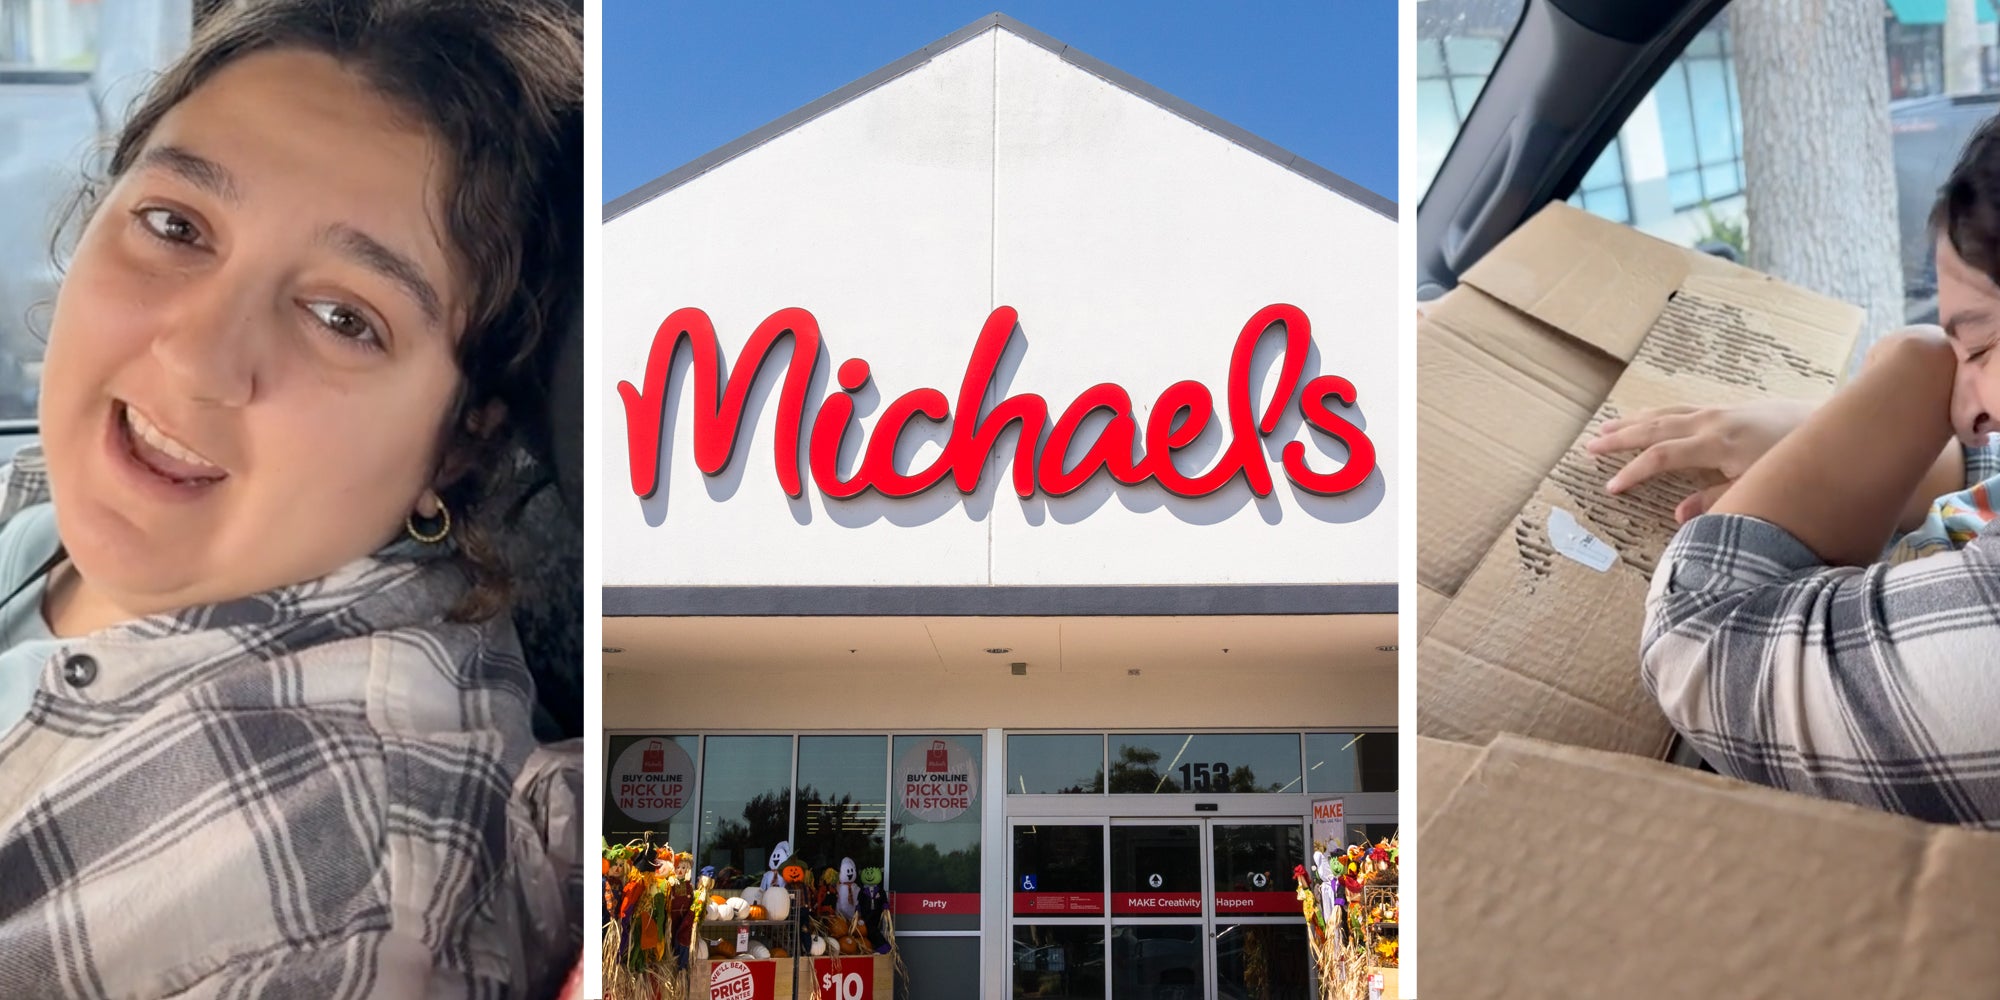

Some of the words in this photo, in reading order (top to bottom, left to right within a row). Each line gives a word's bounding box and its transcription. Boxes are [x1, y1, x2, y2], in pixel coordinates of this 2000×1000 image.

[617, 303, 1376, 499] Michaels
[622, 774, 643, 782] BUY
[645, 774, 683, 782] ONLINE
[907, 774, 927, 782] BUY
[930, 774, 968, 782] ONLINE
[1179, 763, 1229, 792] 153
[621, 784, 656, 796] PICK
[662, 784, 683, 796] UP
[906, 784, 942, 796] PICK
[947, 784, 968, 796] UP
[620, 798, 633, 808] IN
[638, 798, 682, 808] STORE
[906, 798, 919, 808] IN
[924, 798, 968, 808] STORE
[1314, 803, 1343, 819] MAKE
[922, 900, 947, 909] Party
[1128, 899, 1156, 907] MAKE
[1158, 898, 1201, 908] Creativity
[1216, 898, 1254, 907] Happen
[712, 964, 729, 982] WE'LL
[730, 962, 747, 972] BEAT
[711, 977, 750, 1000] PRICE
[822, 972, 864, 1000] $10
